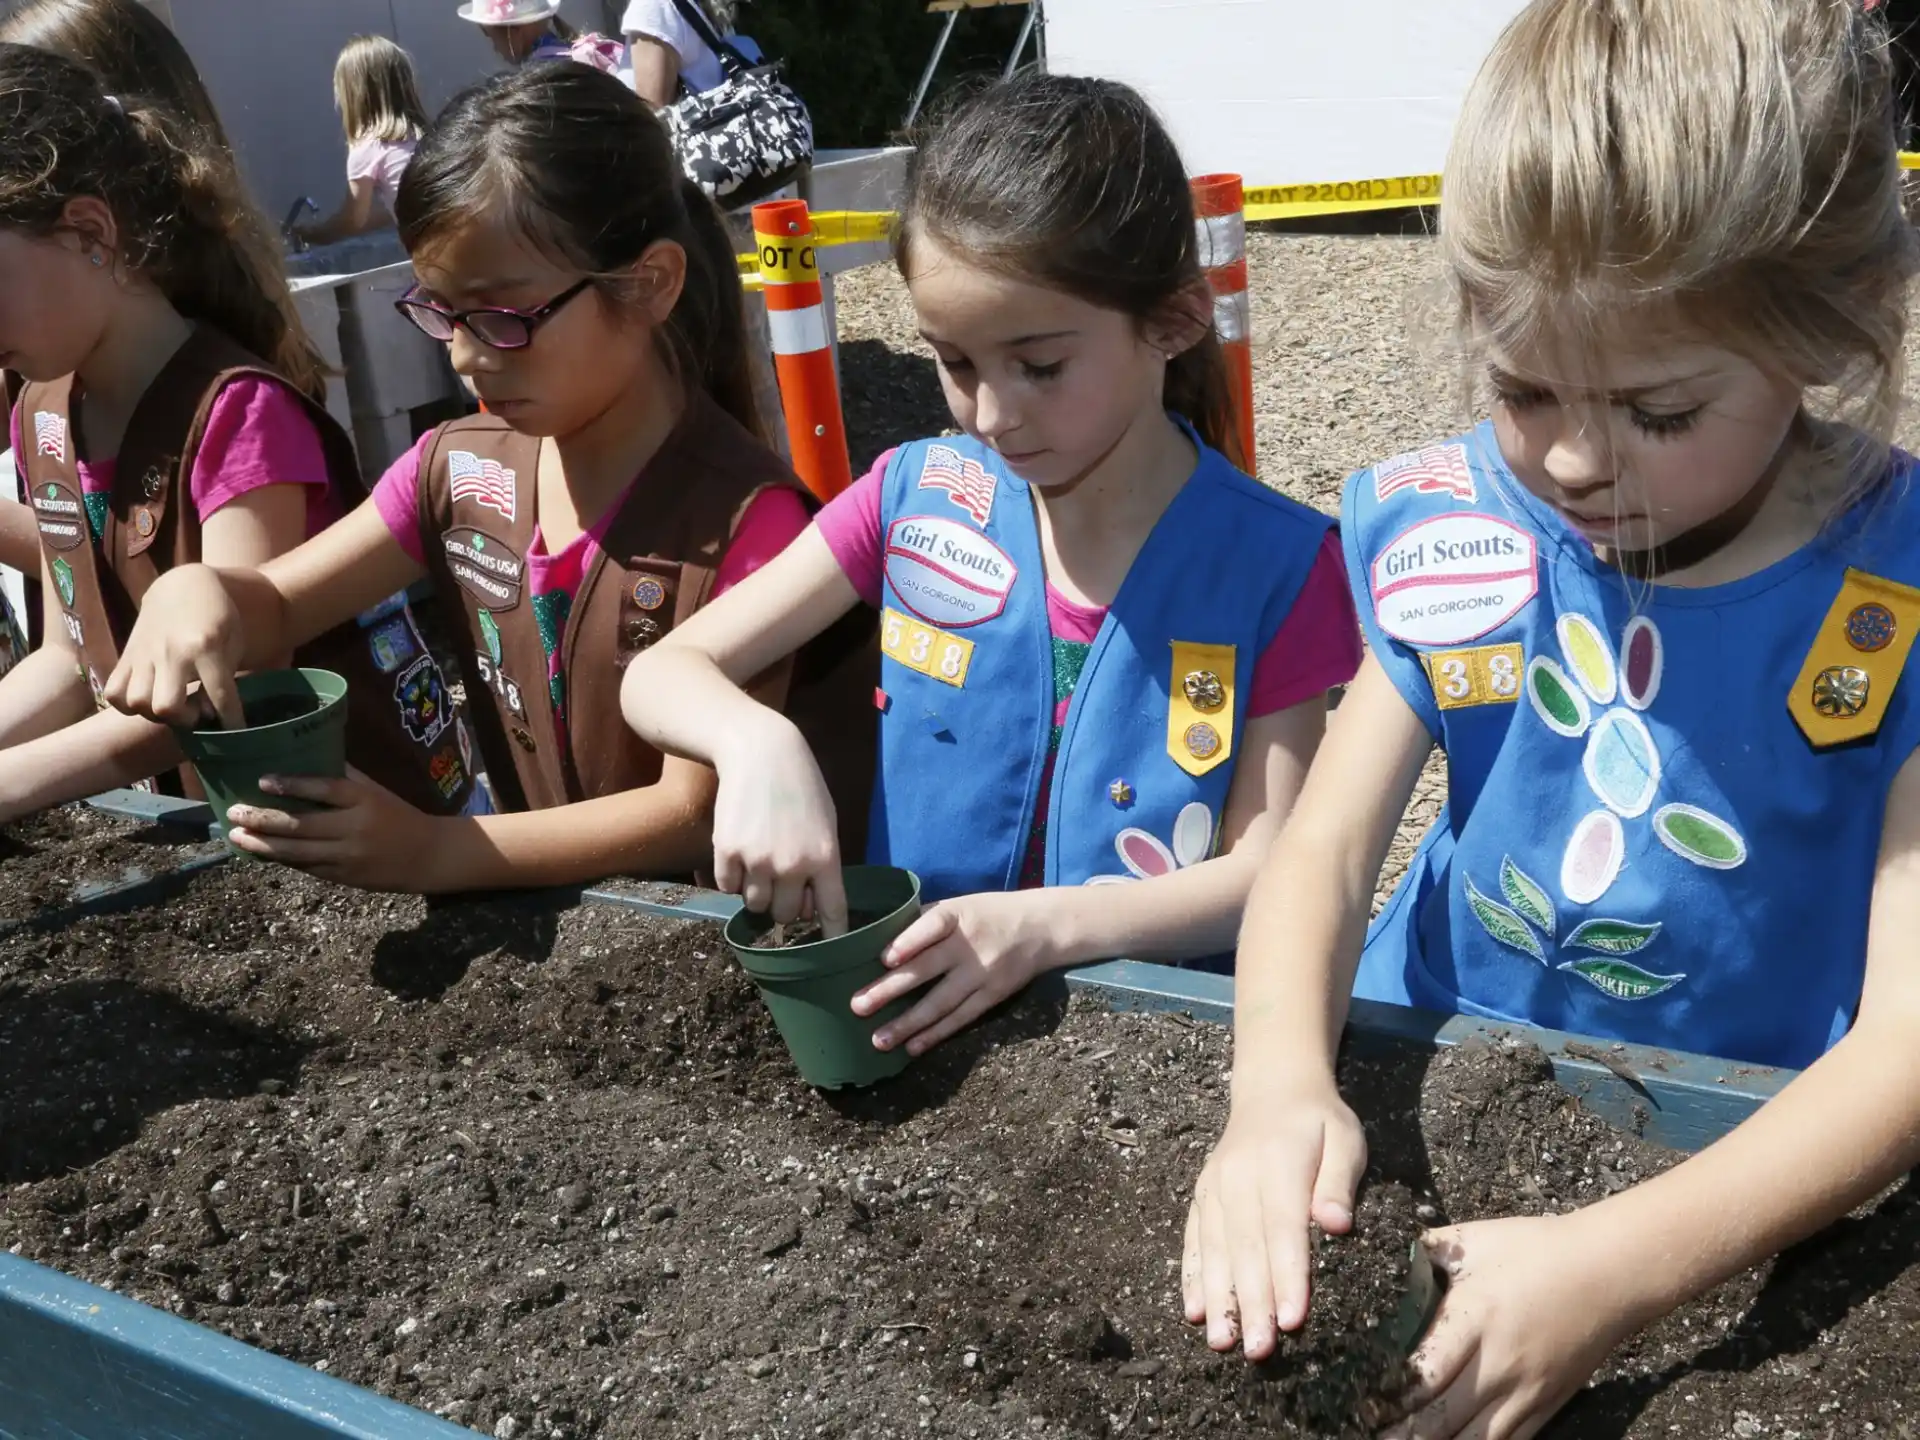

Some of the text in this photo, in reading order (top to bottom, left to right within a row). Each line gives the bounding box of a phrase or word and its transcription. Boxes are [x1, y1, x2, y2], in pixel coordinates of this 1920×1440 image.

[800, 247, 817, 269] C
[901, 524, 939, 553] Girl
[454, 564, 473, 580] SAN
[497, 560, 518, 577] USA
[1386, 542, 1424, 576] Girl
[901, 577, 976, 613] SAN GORGONIO
[1400, 594, 1504, 622] SAN GORGONIO
[1441, 655, 1517, 700] 38
[1633, 985, 1650, 995] UP
